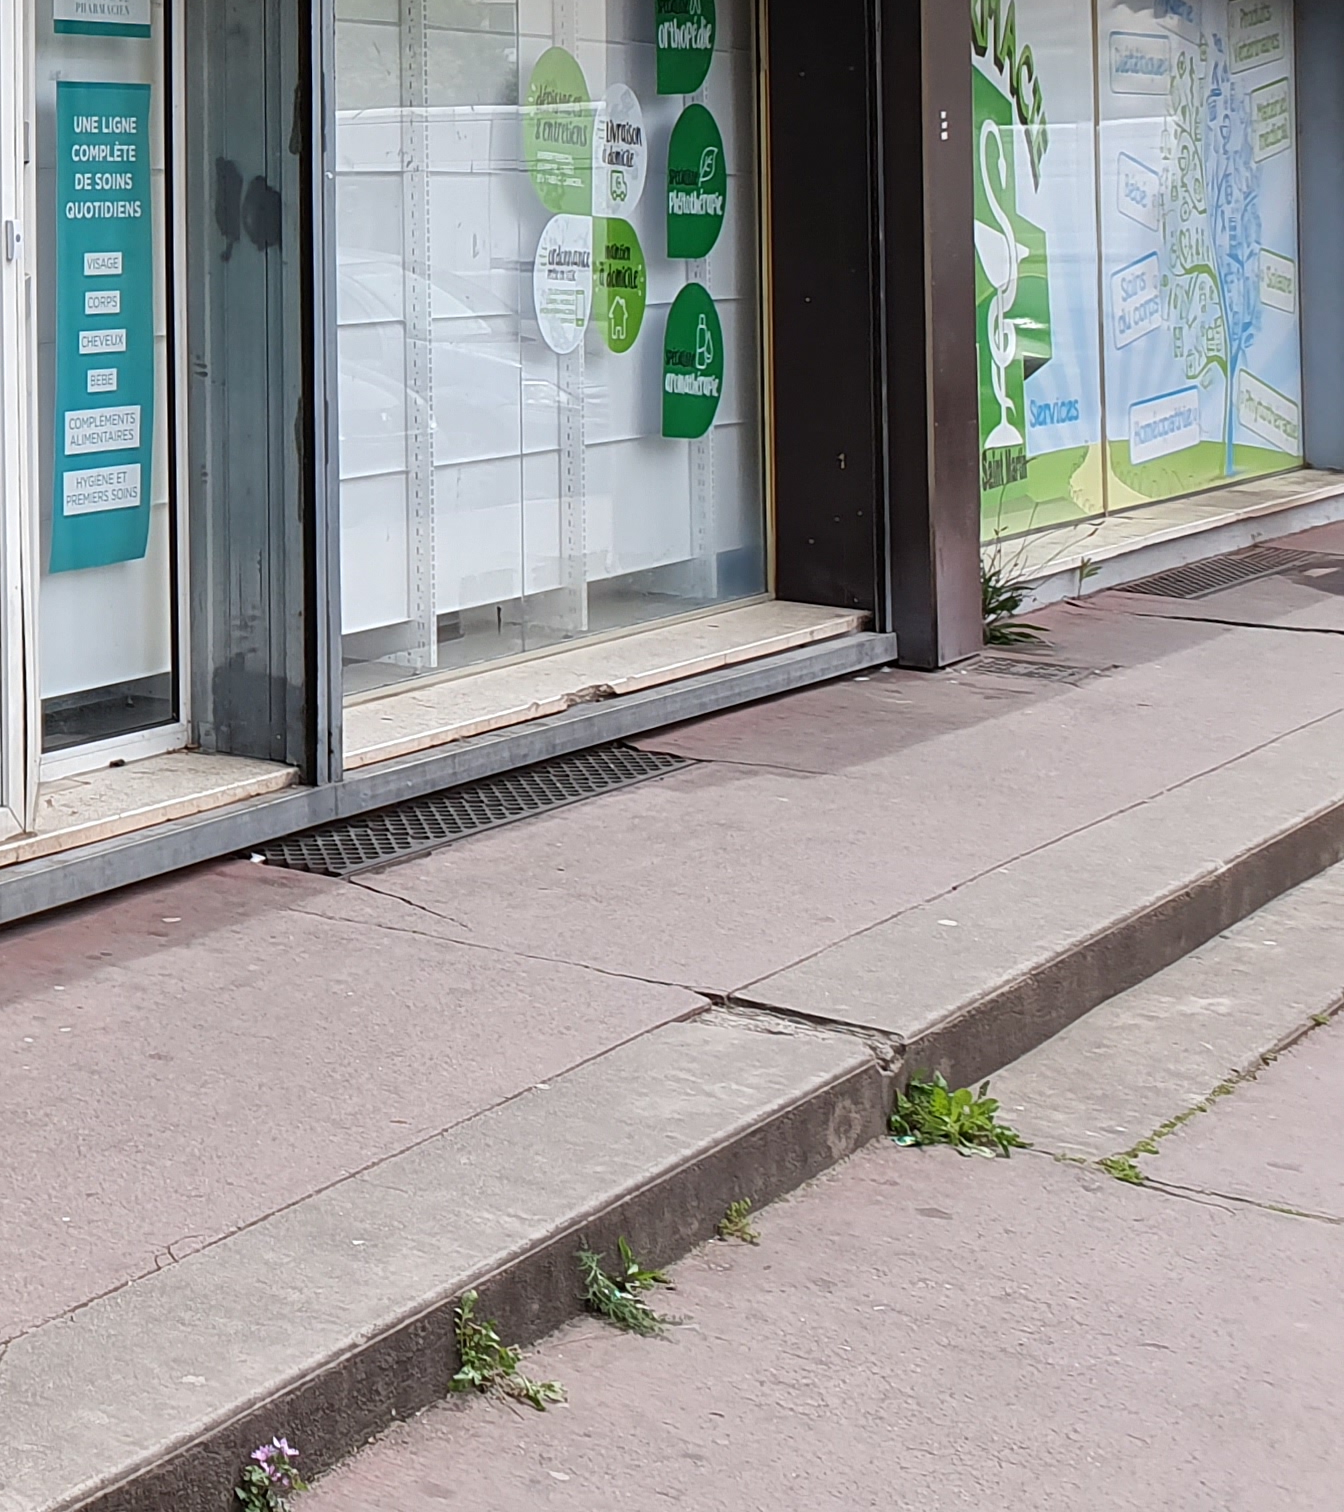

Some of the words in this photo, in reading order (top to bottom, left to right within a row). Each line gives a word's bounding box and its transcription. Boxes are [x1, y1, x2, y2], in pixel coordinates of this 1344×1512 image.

[75, 2, 130, 16] PHARMACIEN
[73, 116, 99, 133] UNE
[102, 116, 137, 134] LIGNE
[71, 141, 136, 162] COMPLÈTE
[75, 173, 91, 190] DE
[95, 172, 133, 190] SOINS
[66, 201, 142, 219] QUOTIDIENS
[86, 256, 119, 270] VISAGE
[87, 295, 118, 309] CORPS
[81, 333, 124, 348] CHEVEUX
[1029, 396, 1080, 429] Services
[70, 428, 134, 447] ALIMENTAIRES
[116, 470, 127, 484] ET
[66, 488, 109, 506] PREMIERS
[111, 486, 138, 501] SOINS
